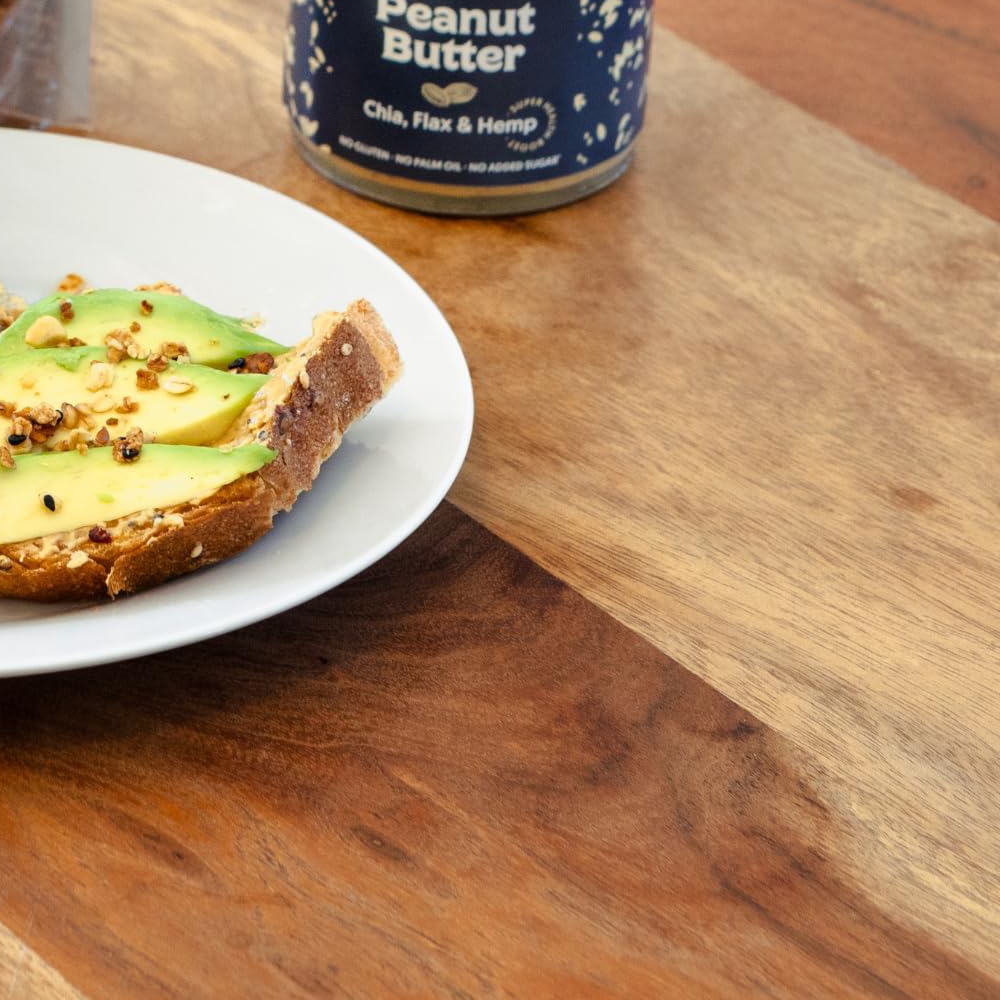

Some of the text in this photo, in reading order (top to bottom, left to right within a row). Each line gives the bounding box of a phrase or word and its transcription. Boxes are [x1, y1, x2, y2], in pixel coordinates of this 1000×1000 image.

[381, 26, 526, 73] Butter
[362, 98, 538, 136] Chia, Flax & Hemp
[394, 153, 413, 167] NO
[468, 161, 487, 174] NO
